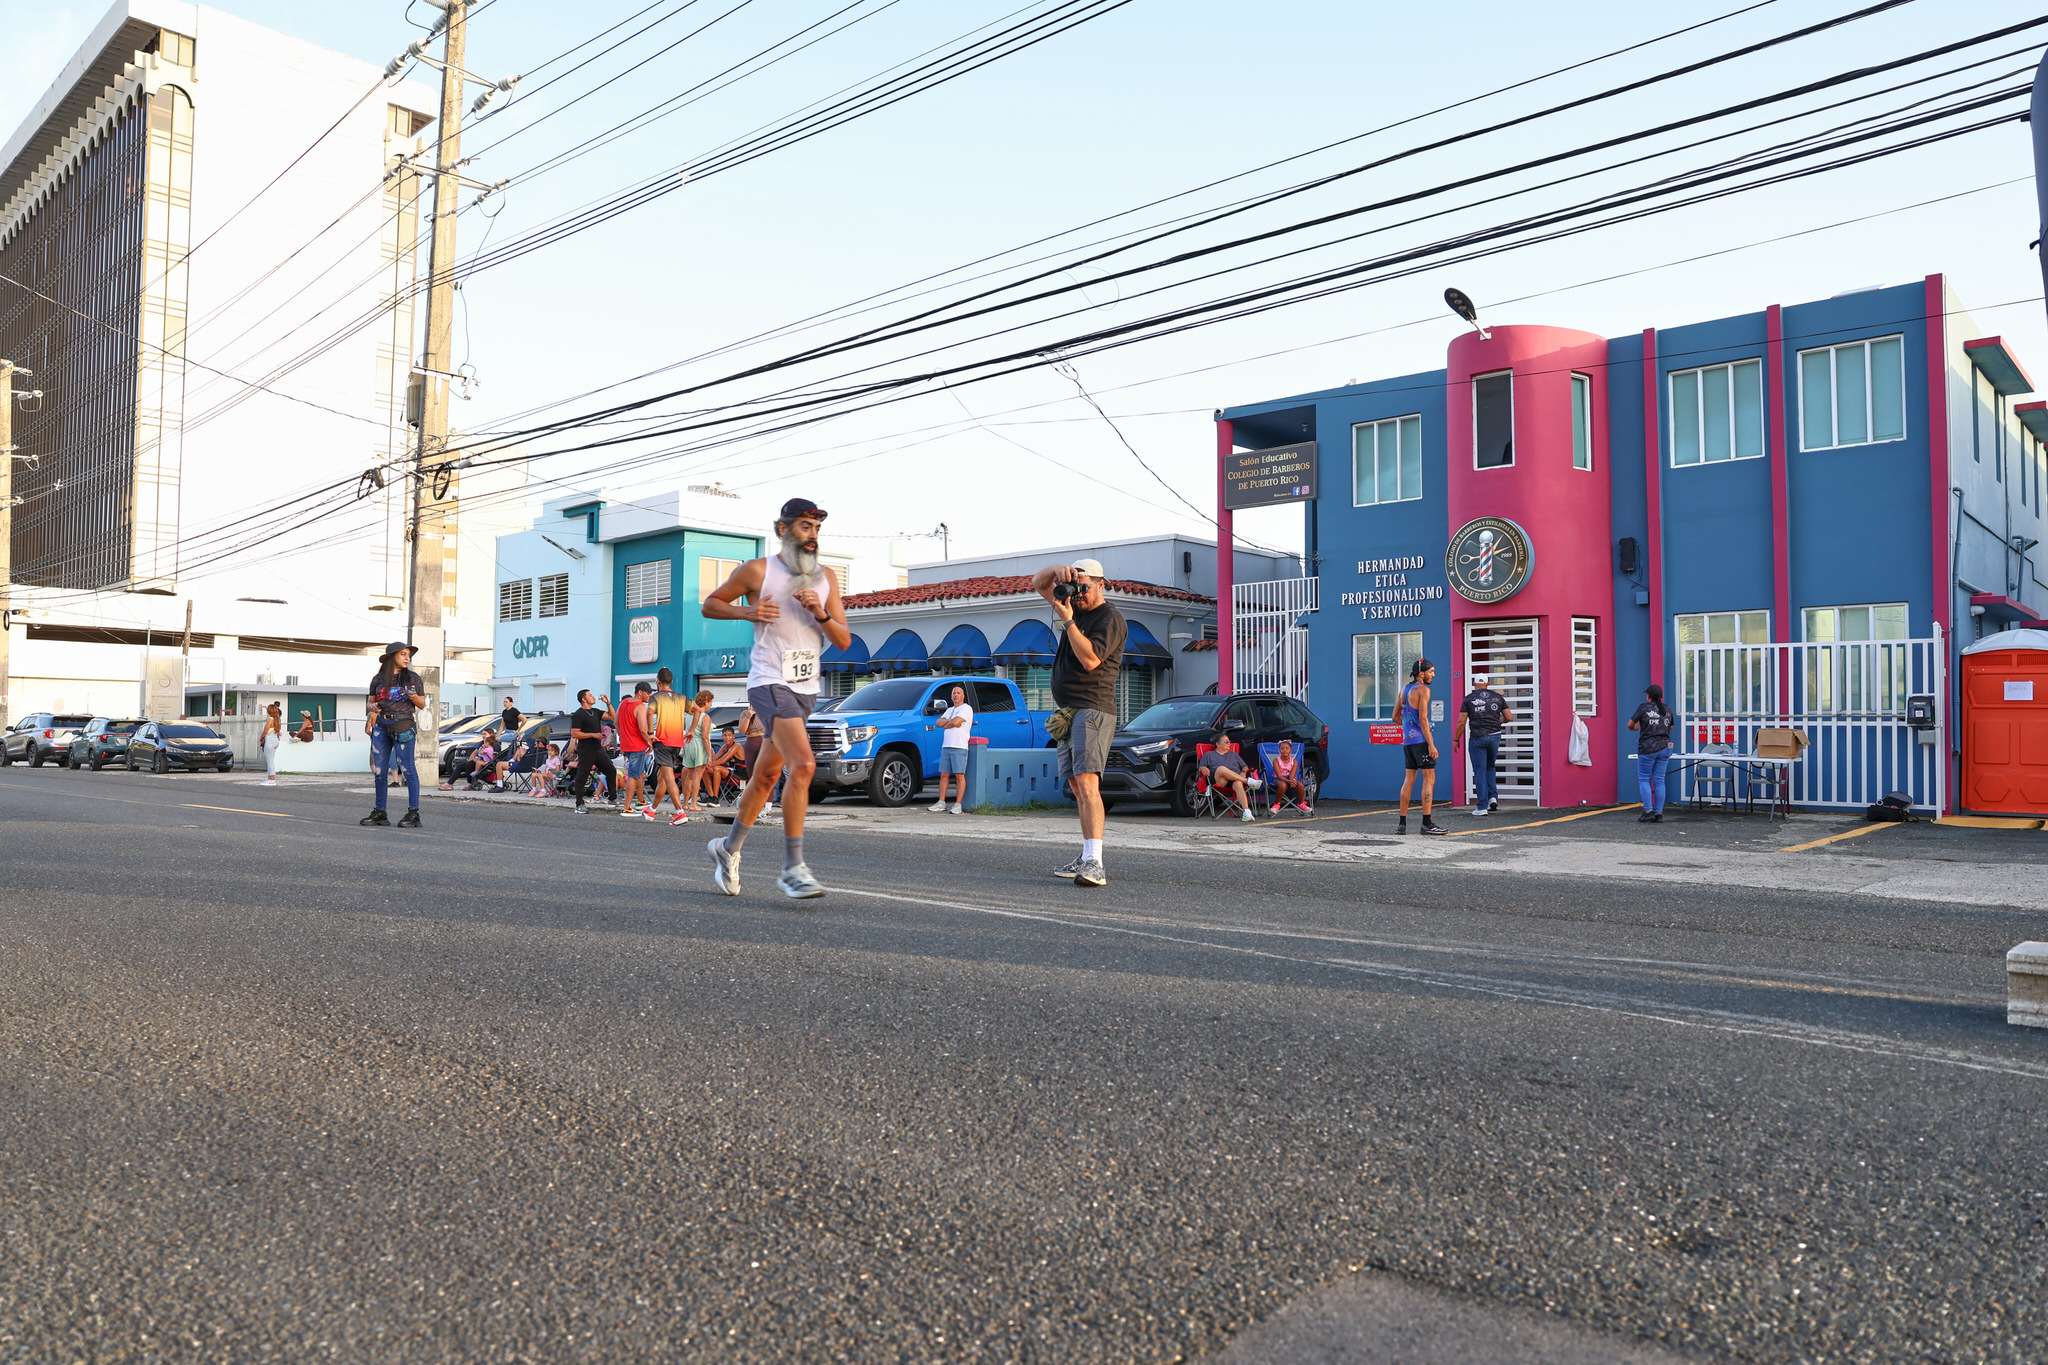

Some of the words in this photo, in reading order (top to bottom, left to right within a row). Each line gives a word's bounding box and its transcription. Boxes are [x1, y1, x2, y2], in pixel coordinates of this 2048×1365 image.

[1239, 457, 1259, 467] Salón
[1262, 452, 1298, 463] Educativo
[1228, 469, 1259, 480] COLEGIO
[1272, 462, 1310, 474] BARBEROS
[1238, 482, 1248, 490] DE
[1250, 478, 1278, 488] PUERTO
[1280, 475, 1299, 484] RICO
[1448, 544, 1456, 567] COLEGIO
[1459, 522, 1481, 539] BARBEROS
[1486, 520, 1510, 531] ESTILISTAS
[1358, 556, 1424, 573] HERMANDAD
[1375, 573, 1406, 588] ETICA
[1341, 586, 1443, 605] PROFESIONALISMO
[1459, 585, 1492, 599] PUERTO
[1493, 583, 1513, 598] RICO
[1362, 607, 1368, 619] Y
[1371, 604, 1421, 619] SERVICIO
[721, 655, 735, 668] 25
[793, 663, 813, 677] 193
